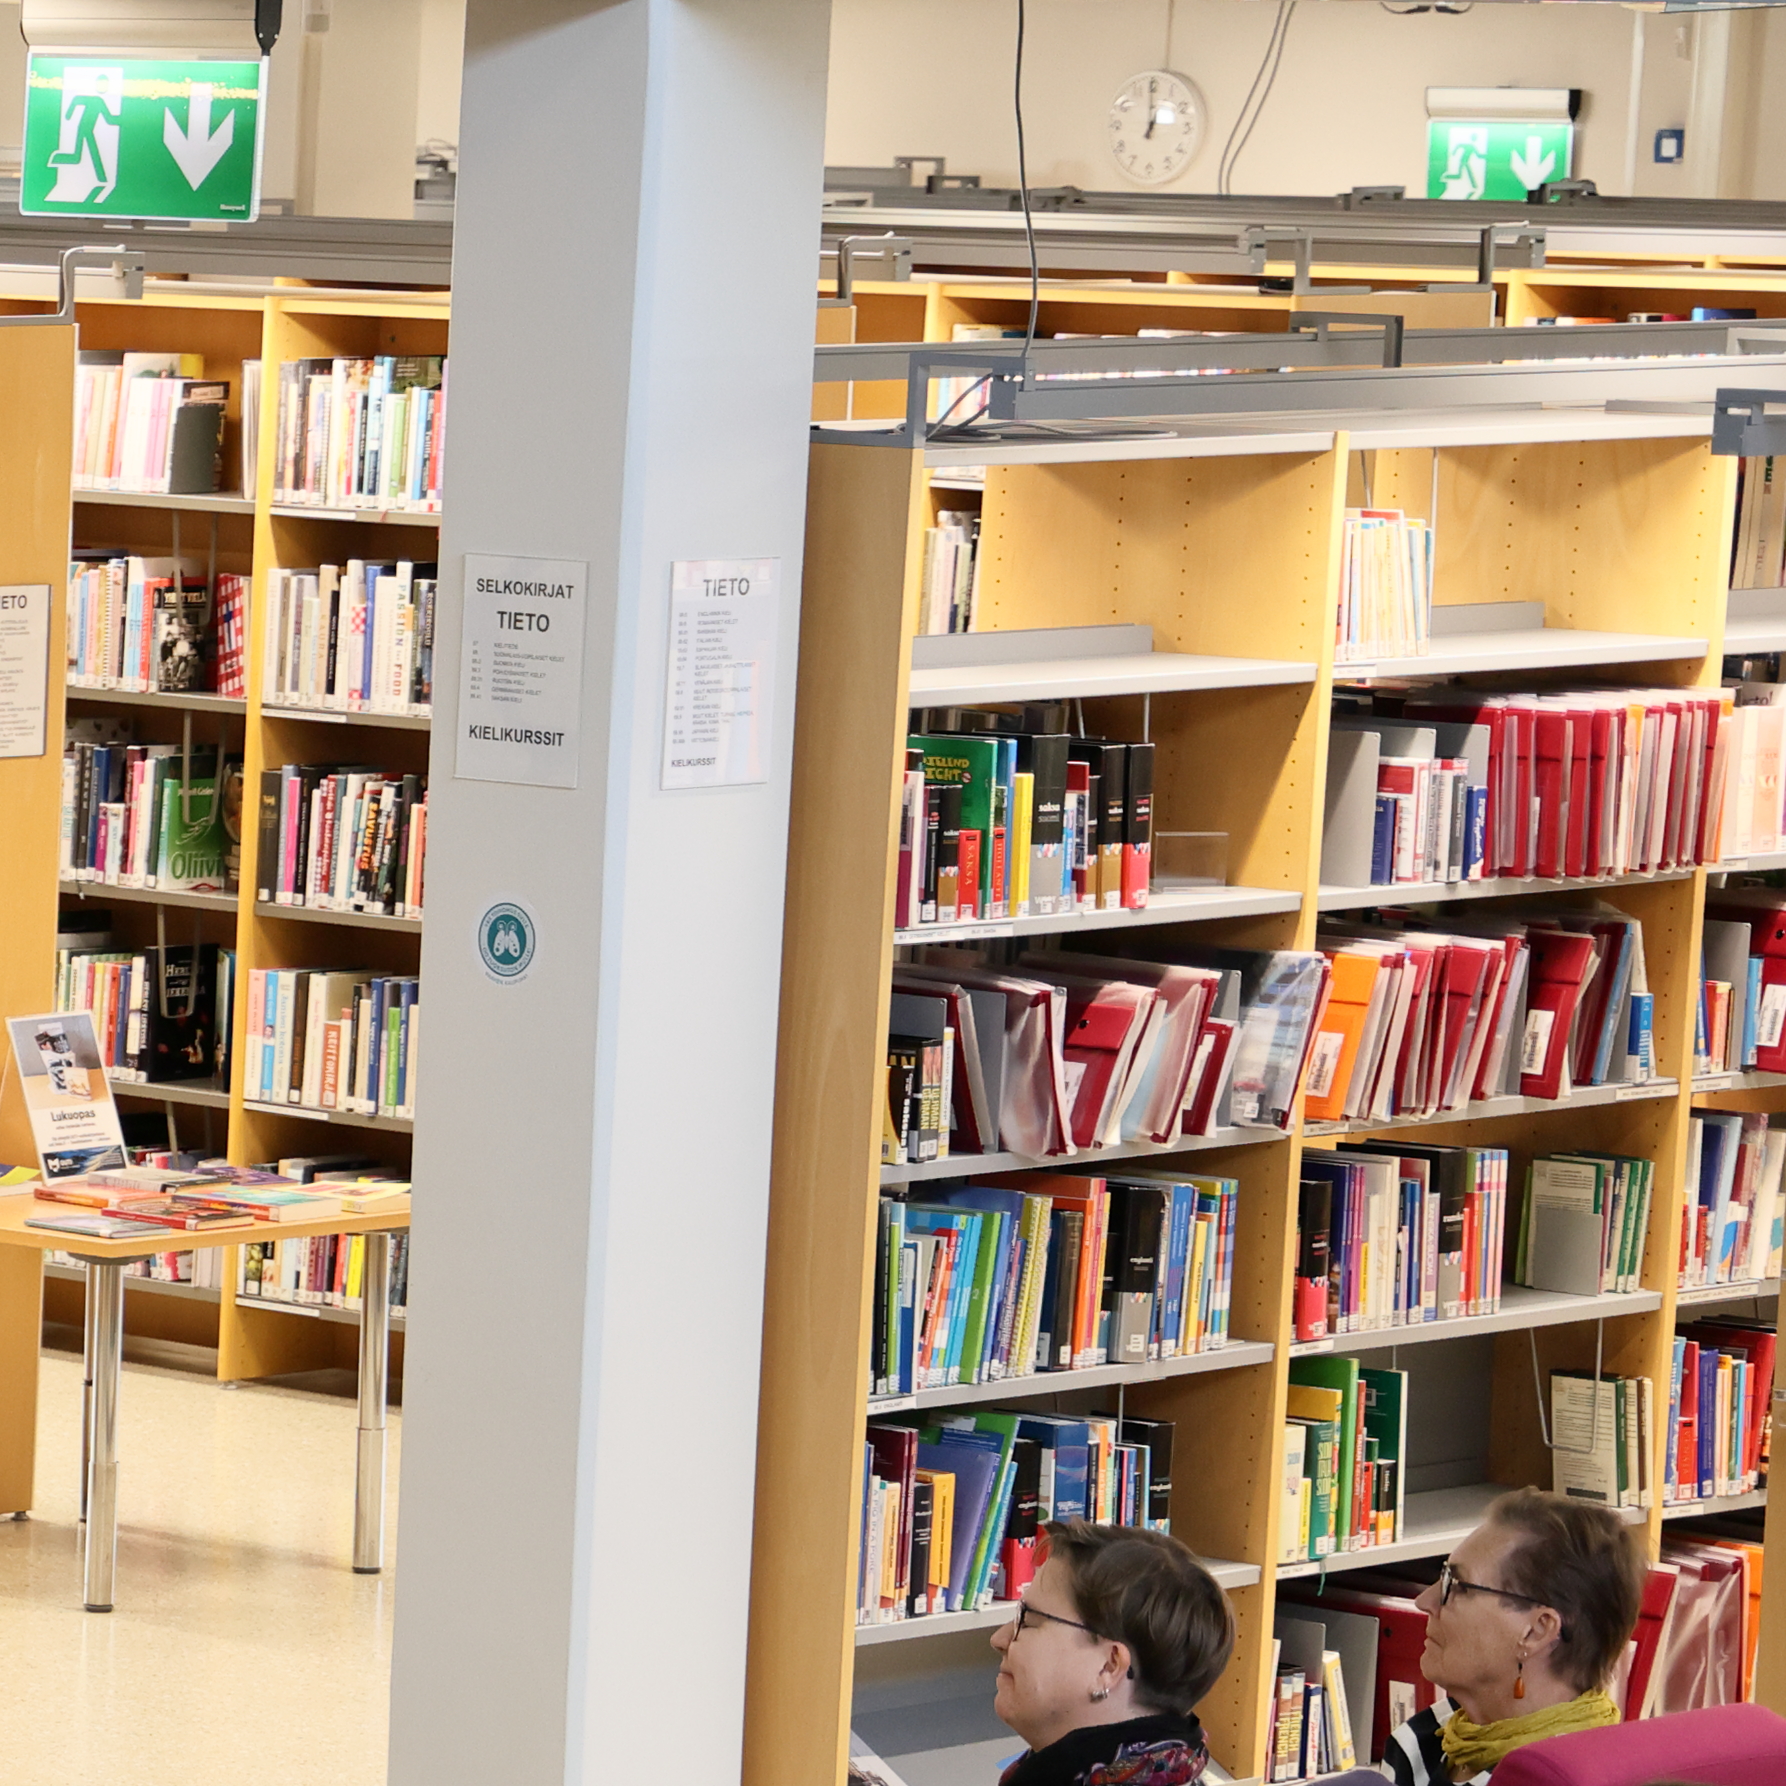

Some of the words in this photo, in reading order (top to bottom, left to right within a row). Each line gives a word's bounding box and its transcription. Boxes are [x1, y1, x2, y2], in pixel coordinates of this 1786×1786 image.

[476, 578, 574, 599] SELKOKIRJAT
[703, 577, 750, 597] TIETO
[396, 583, 407, 647] PASSION
[497, 611, 550, 632] TIETO
[392, 663, 403, 697] FOOD
[469, 725, 565, 747] KIELIKURSSIT
[671, 758, 717, 768] KIELIKURSSIT
[1039, 803, 1060, 812] saksa
[360, 802, 379, 870] SAVUSTUS
[965, 844, 975, 886] SAKSA
[50, 1110, 96, 1122] Lukuopas
[921, 1087, 931, 1131] GERMAN
[929, 1087, 940, 1131] GERMAN
[1277, 1712, 1290, 1758] FRENCH
